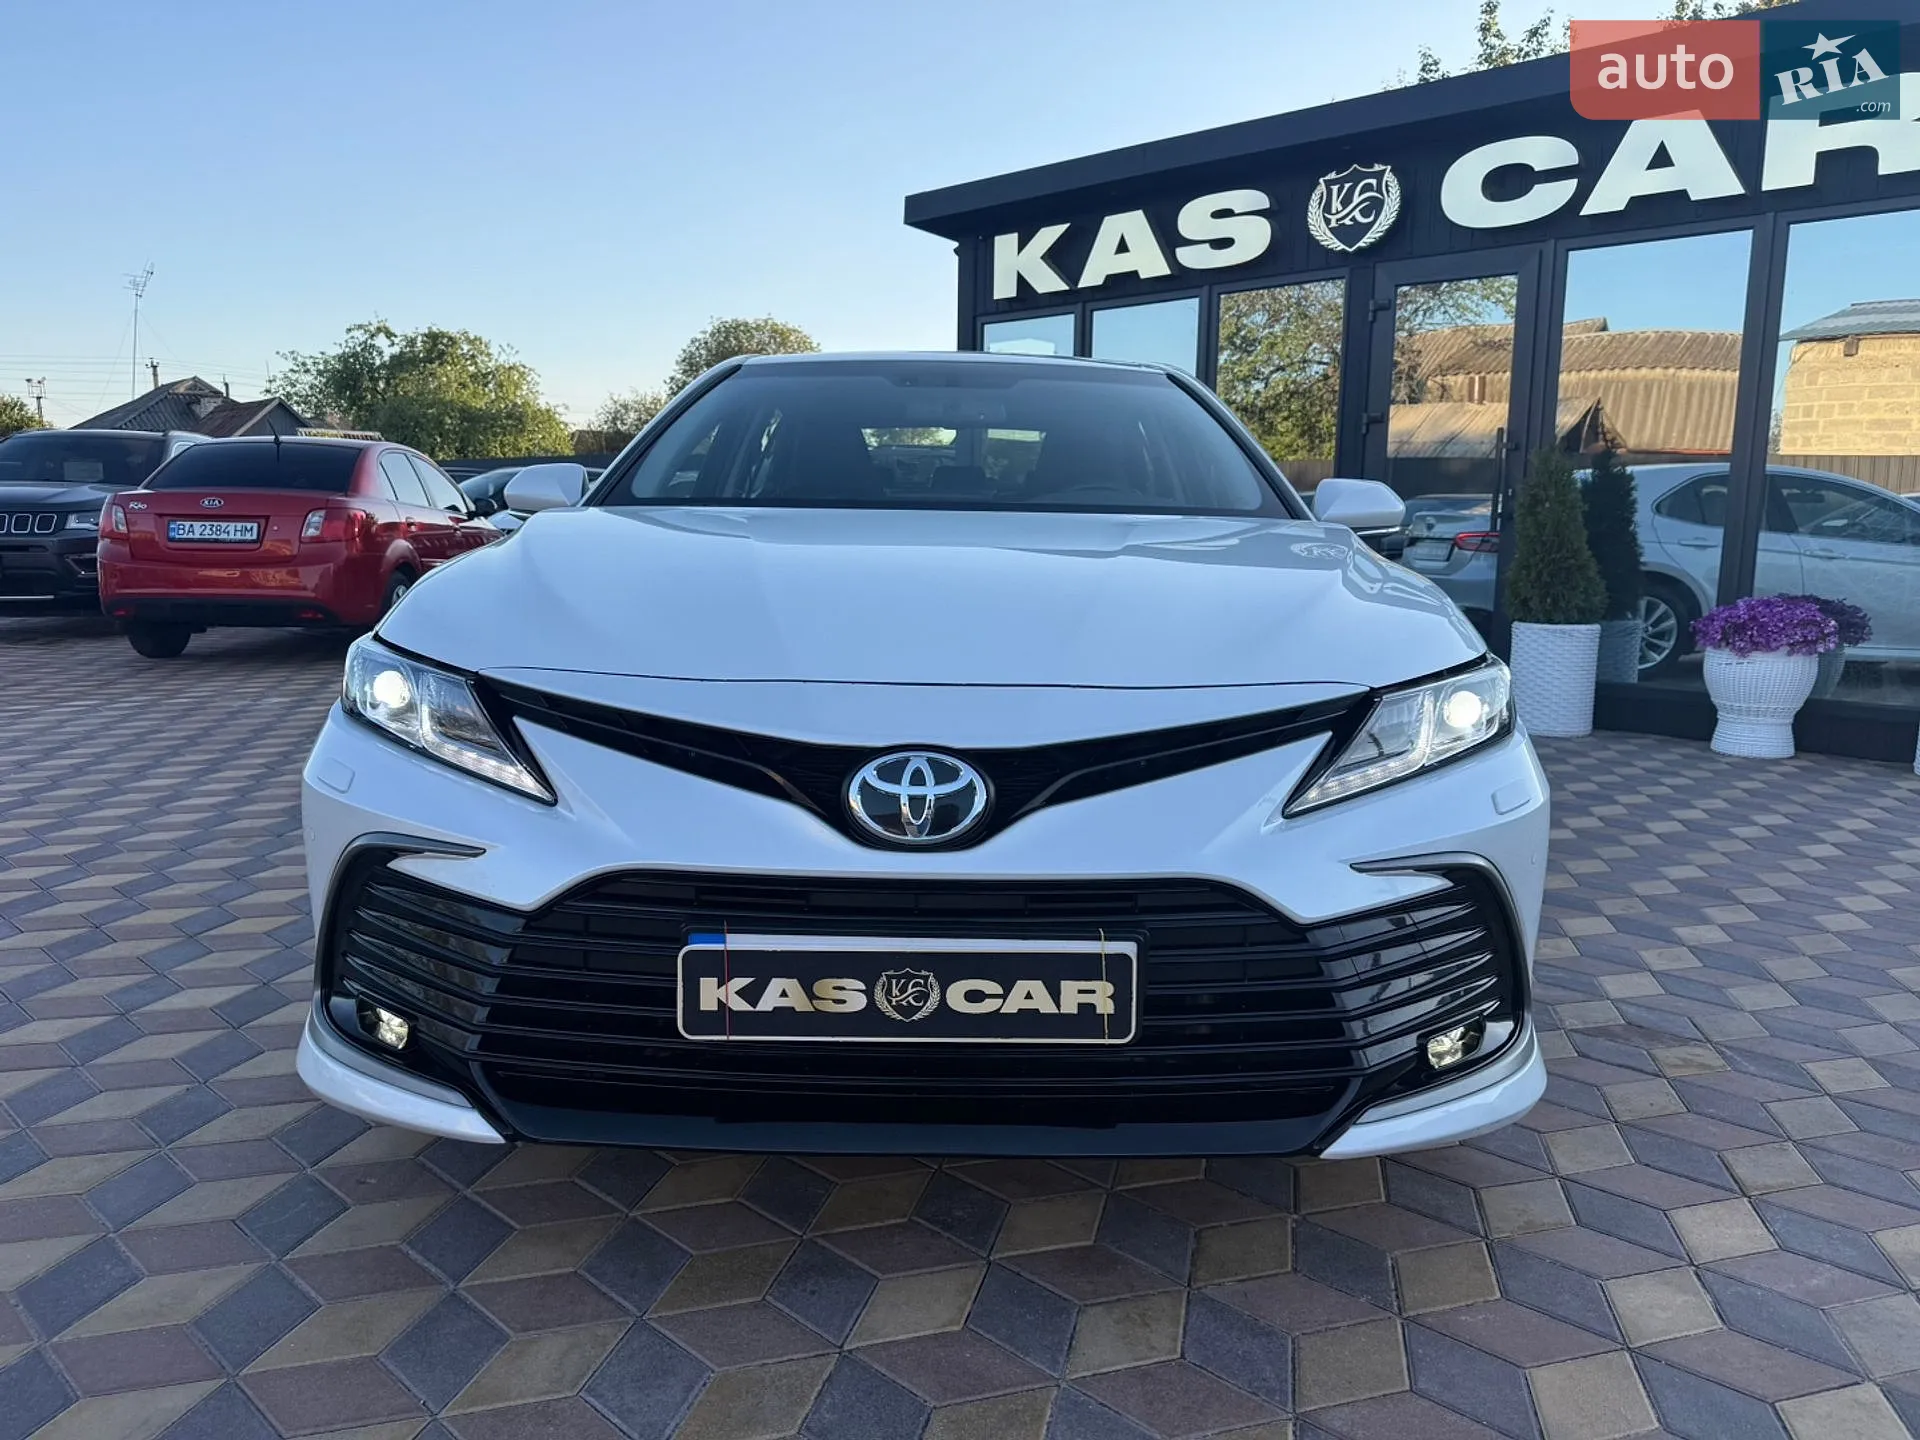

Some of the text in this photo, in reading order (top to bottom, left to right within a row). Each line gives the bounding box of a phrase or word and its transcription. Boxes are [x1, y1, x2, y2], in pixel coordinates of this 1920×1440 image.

[993, 188, 1272, 300] KAS
[1440, 72, 1920, 231] CAR
[177, 523, 254, 537] BA 2384 HM
[699, 977, 868, 1014] KAS
[945, 978, 1116, 1015] CAR
